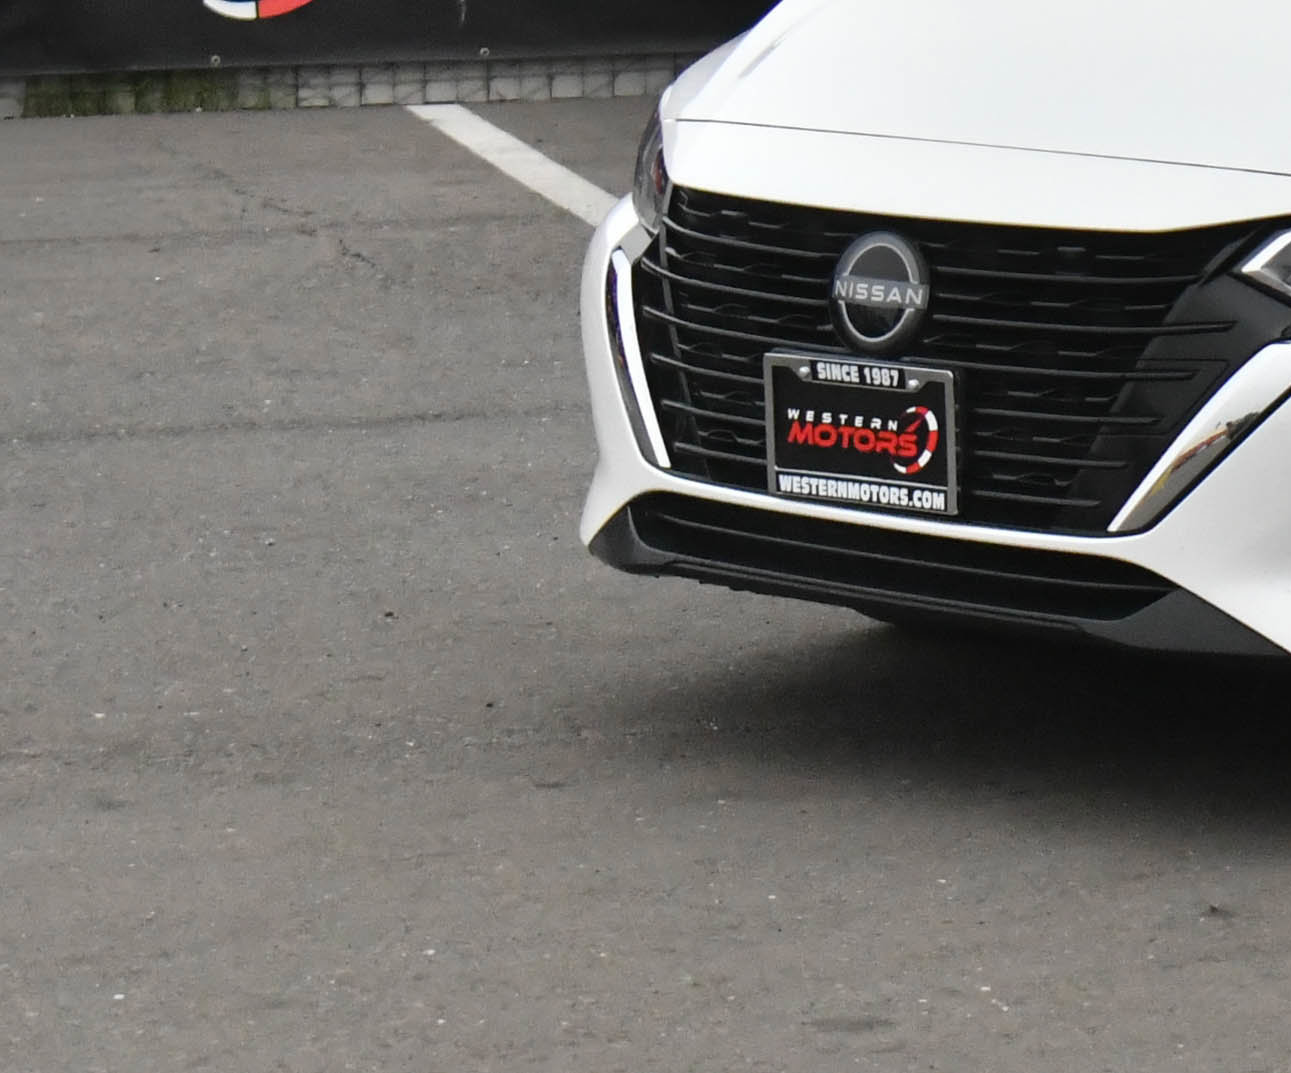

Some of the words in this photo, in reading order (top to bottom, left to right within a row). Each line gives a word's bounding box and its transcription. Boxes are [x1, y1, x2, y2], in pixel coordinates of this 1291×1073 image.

[834, 280, 923, 305] NISSAN
[816, 362, 860, 383] SINCE
[787, 408, 898, 432] WESTERN
[787, 420, 918, 457] MOTORS
[778, 474, 945, 510] WESTERNMOTORS.COM
